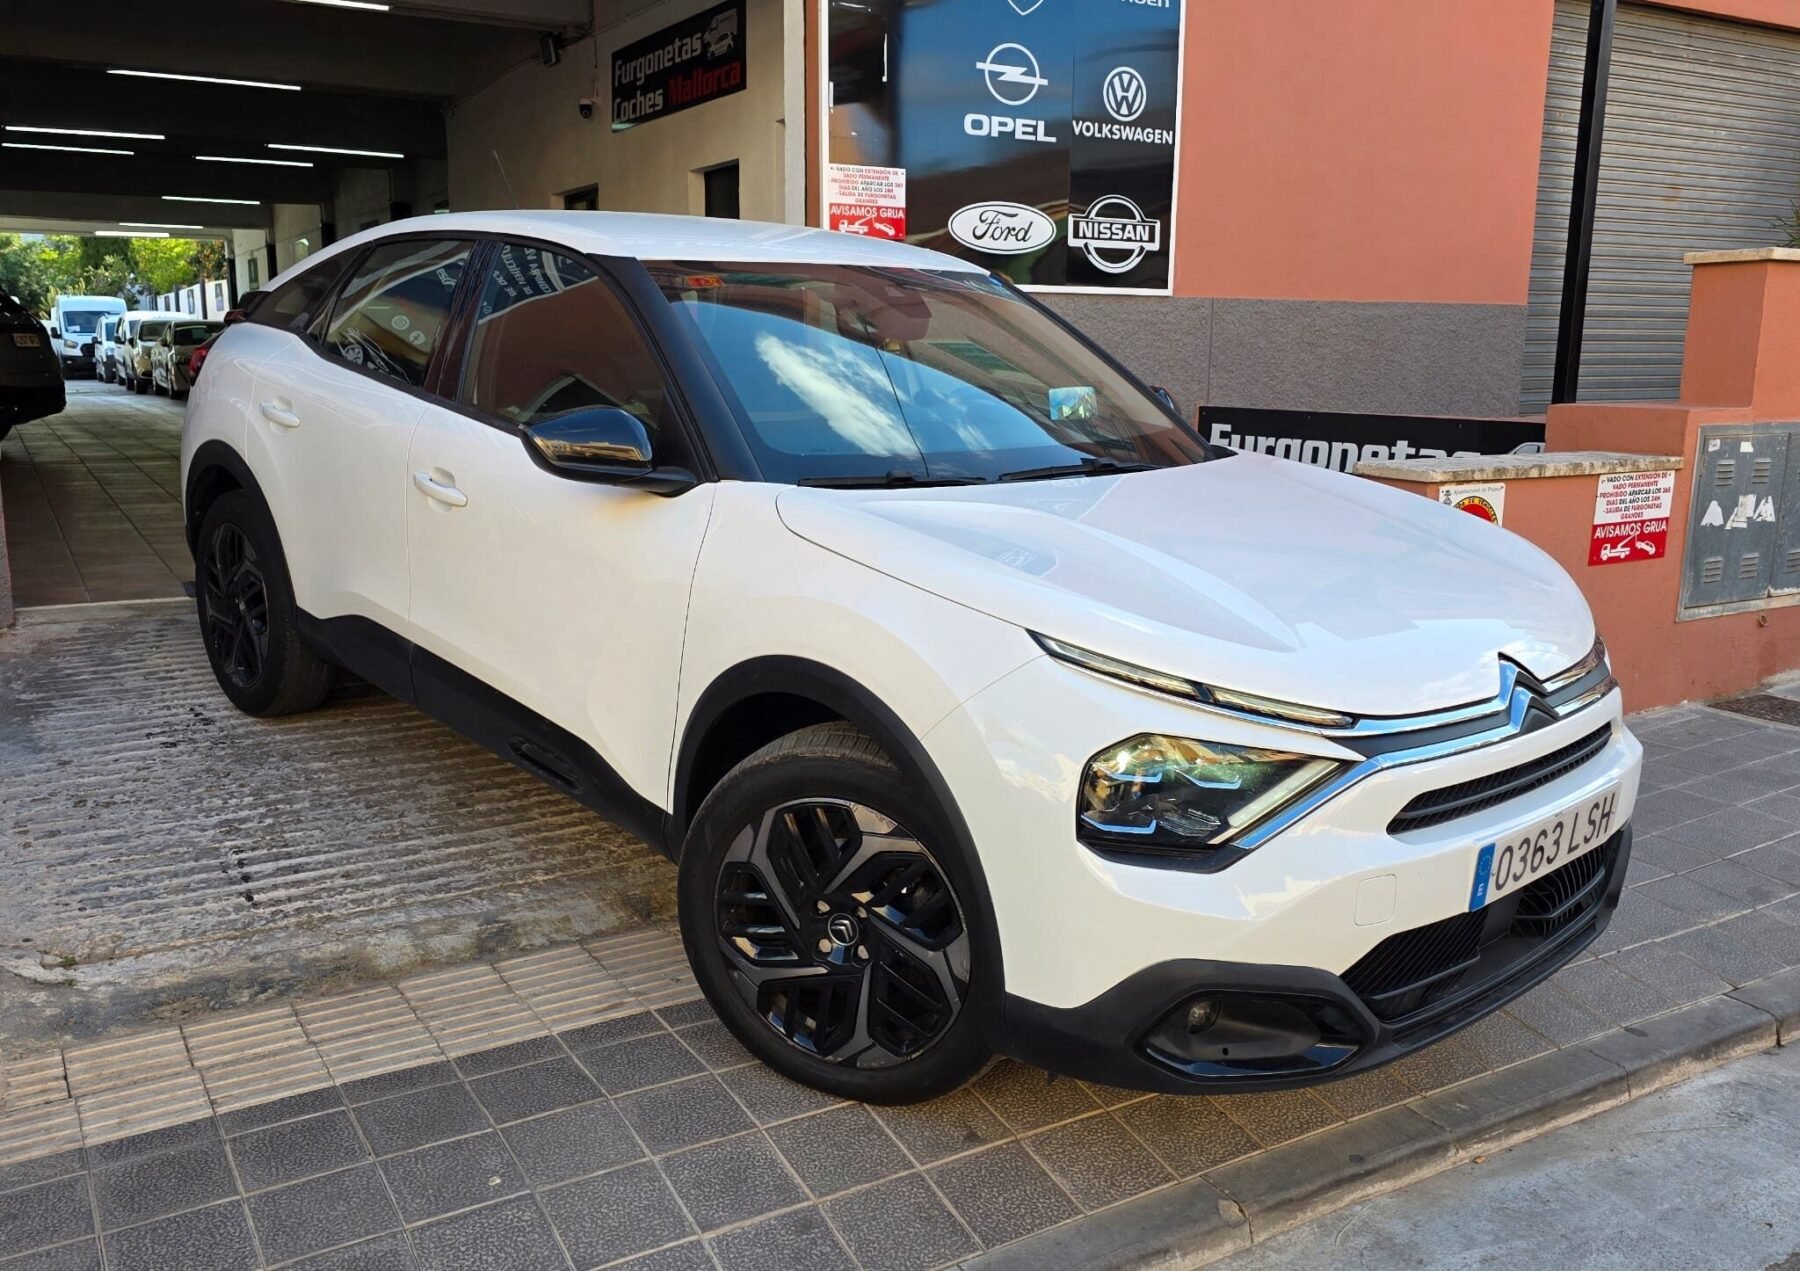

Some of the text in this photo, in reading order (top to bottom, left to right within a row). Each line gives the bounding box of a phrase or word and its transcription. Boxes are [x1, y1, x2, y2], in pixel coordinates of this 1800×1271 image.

[615, 33, 702, 88] Furgonetas
[614, 62, 740, 122] Coches Mallorca
[963, 113, 1057, 143] OPEL
[1072, 120, 1174, 145] VOLKSWAGEN
[830, 205, 904, 218] AVISAMOS GRUA
[972, 209, 1034, 243] Ford
[1078, 222, 1150, 242] NISSAN
[1629, 488, 1651, 496] APARCAR
[1629, 496, 1640, 504] AÑO
[1620, 512, 1643, 520] GRANDES
[1631, 503, 1662, 511] FURGONETAS
[1594, 520, 1667, 539] AVISAMOS GRUA
[1495, 792, 1616, 891] 0363 LSH
